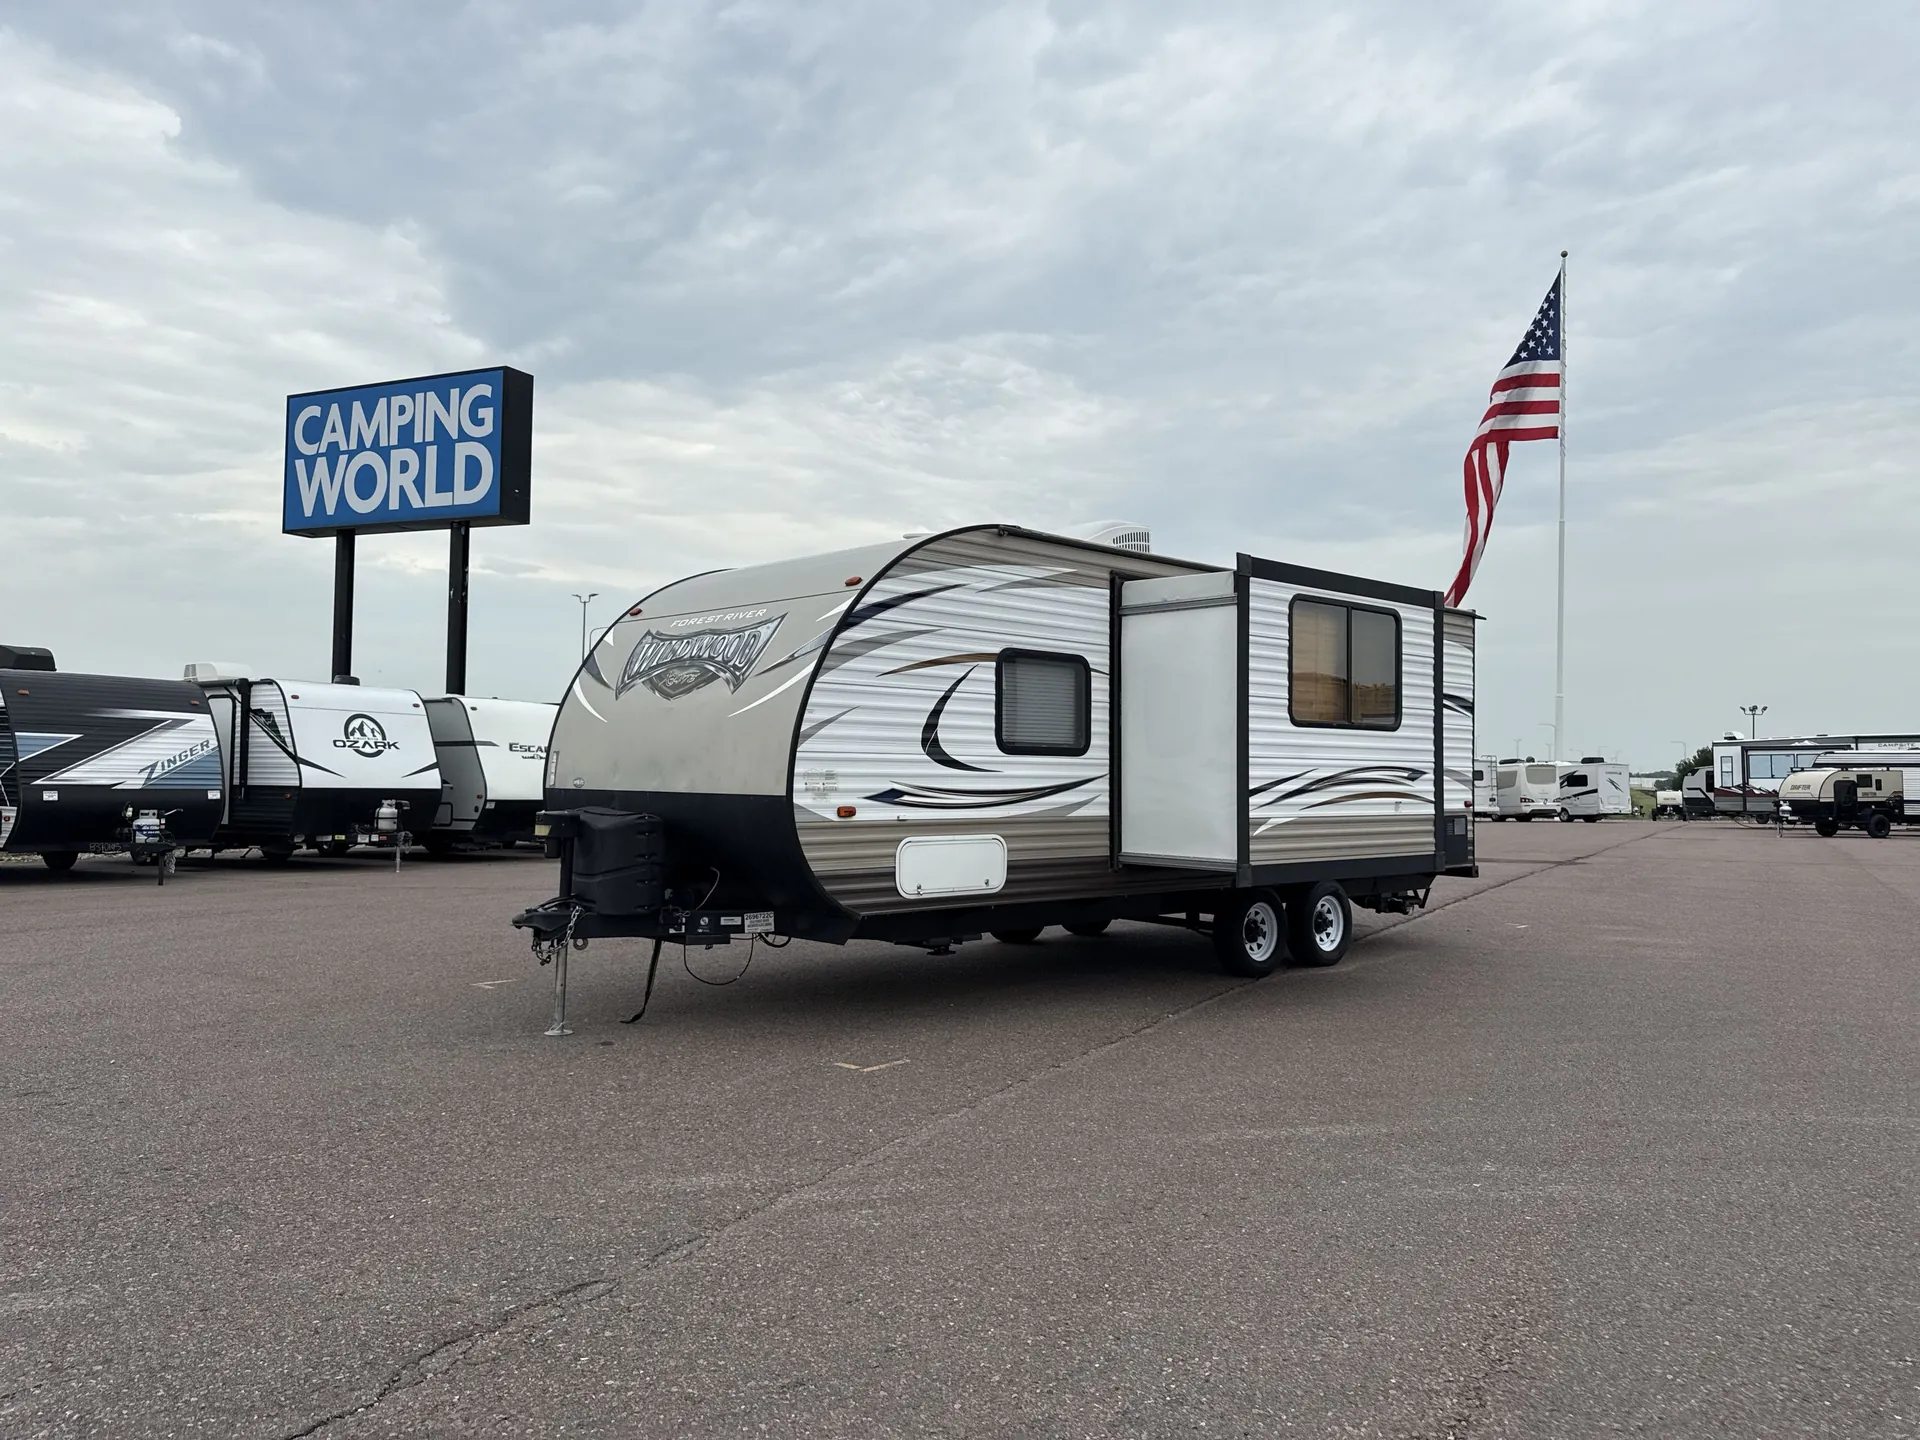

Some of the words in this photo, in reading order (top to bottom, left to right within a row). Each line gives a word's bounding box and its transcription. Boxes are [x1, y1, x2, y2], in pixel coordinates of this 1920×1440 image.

[294, 383, 494, 456] CAMPING
[295, 441, 494, 517] WORLD
[670, 614, 724, 628] FOREST
[725, 608, 767, 621] RIVER
[632, 630, 761, 675] WILDWOOD
[138, 739, 210, 786] ZINGER
[332, 739, 400, 750] OZARK
[745, 911, 774, 920] 2696722C
